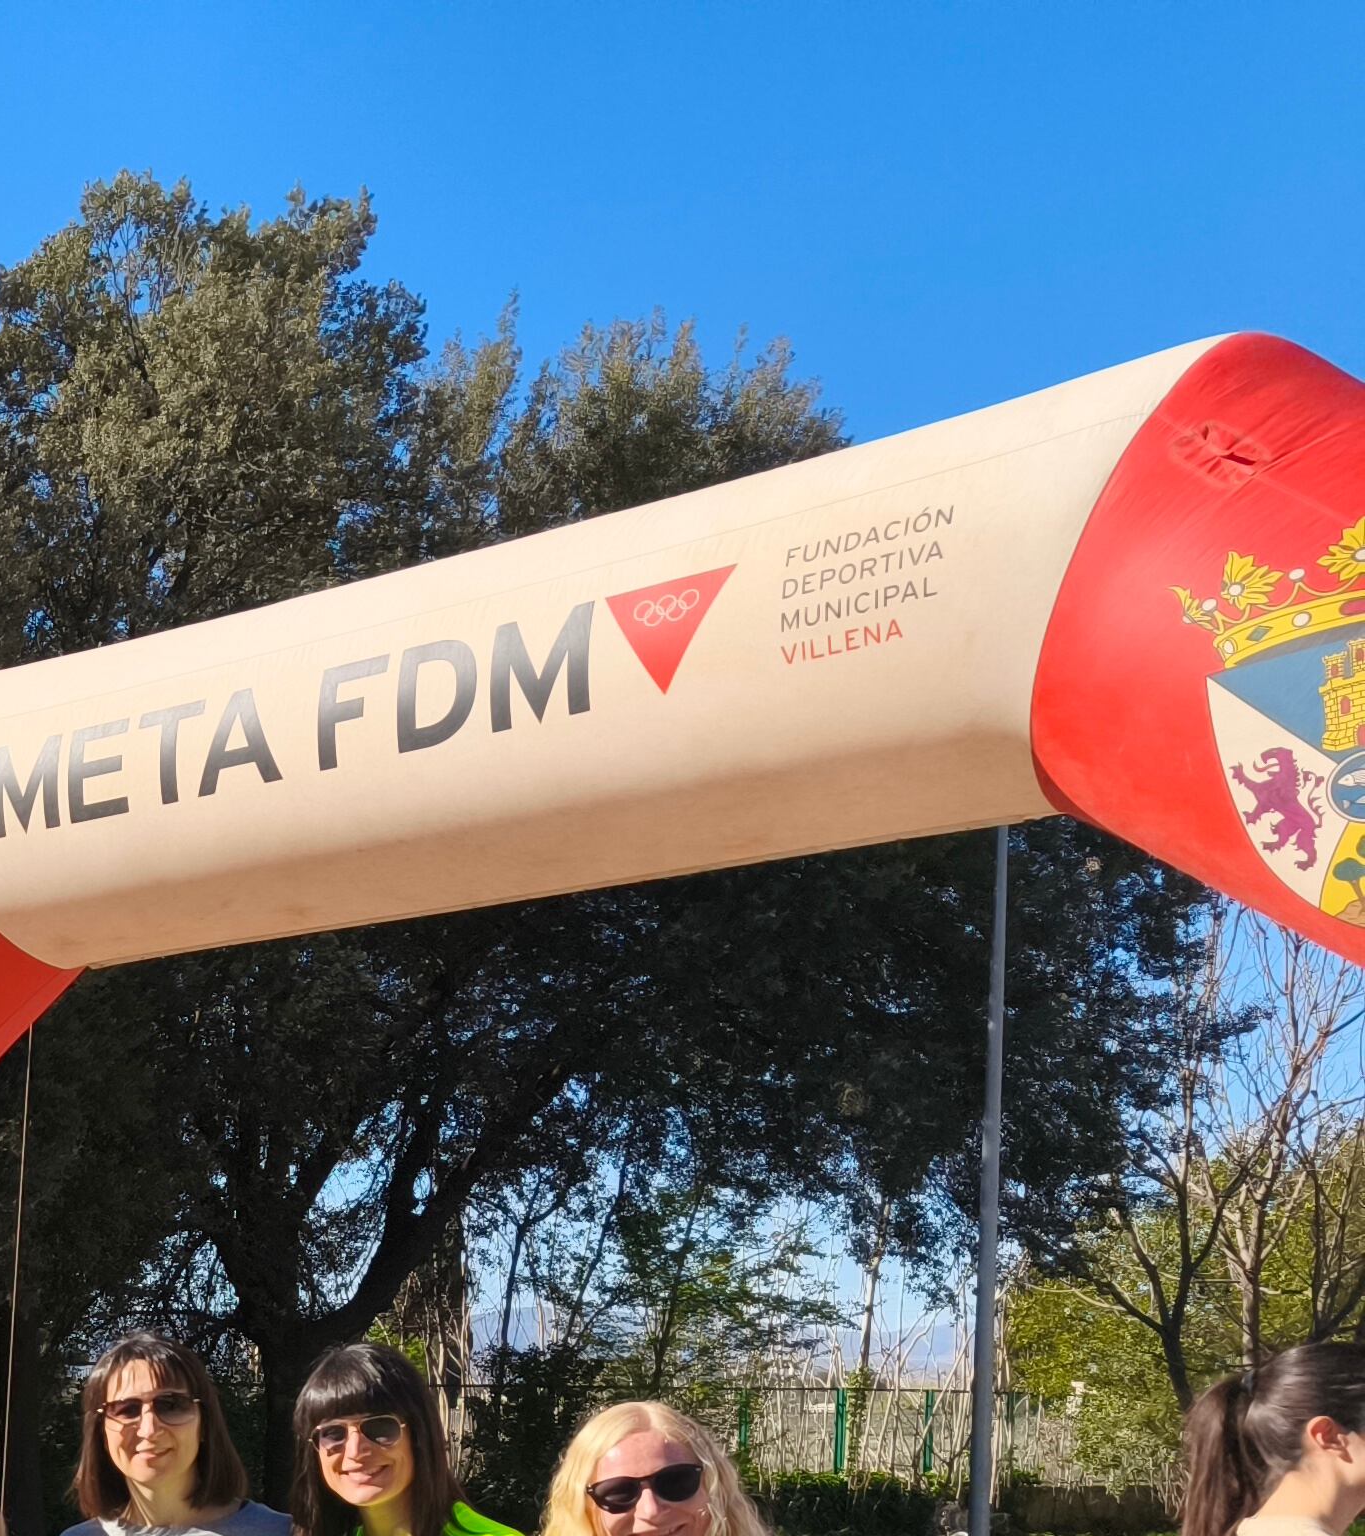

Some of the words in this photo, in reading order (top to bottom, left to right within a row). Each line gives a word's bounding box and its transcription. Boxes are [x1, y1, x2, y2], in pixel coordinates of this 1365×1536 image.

[785, 504, 954, 568] FUNDACIÓN
[781, 540, 944, 600] DEPORTIVA
[780, 577, 938, 632] MUNICIPAL
[780, 619, 904, 665] VILLENA
[318, 601, 595, 771] FDM
